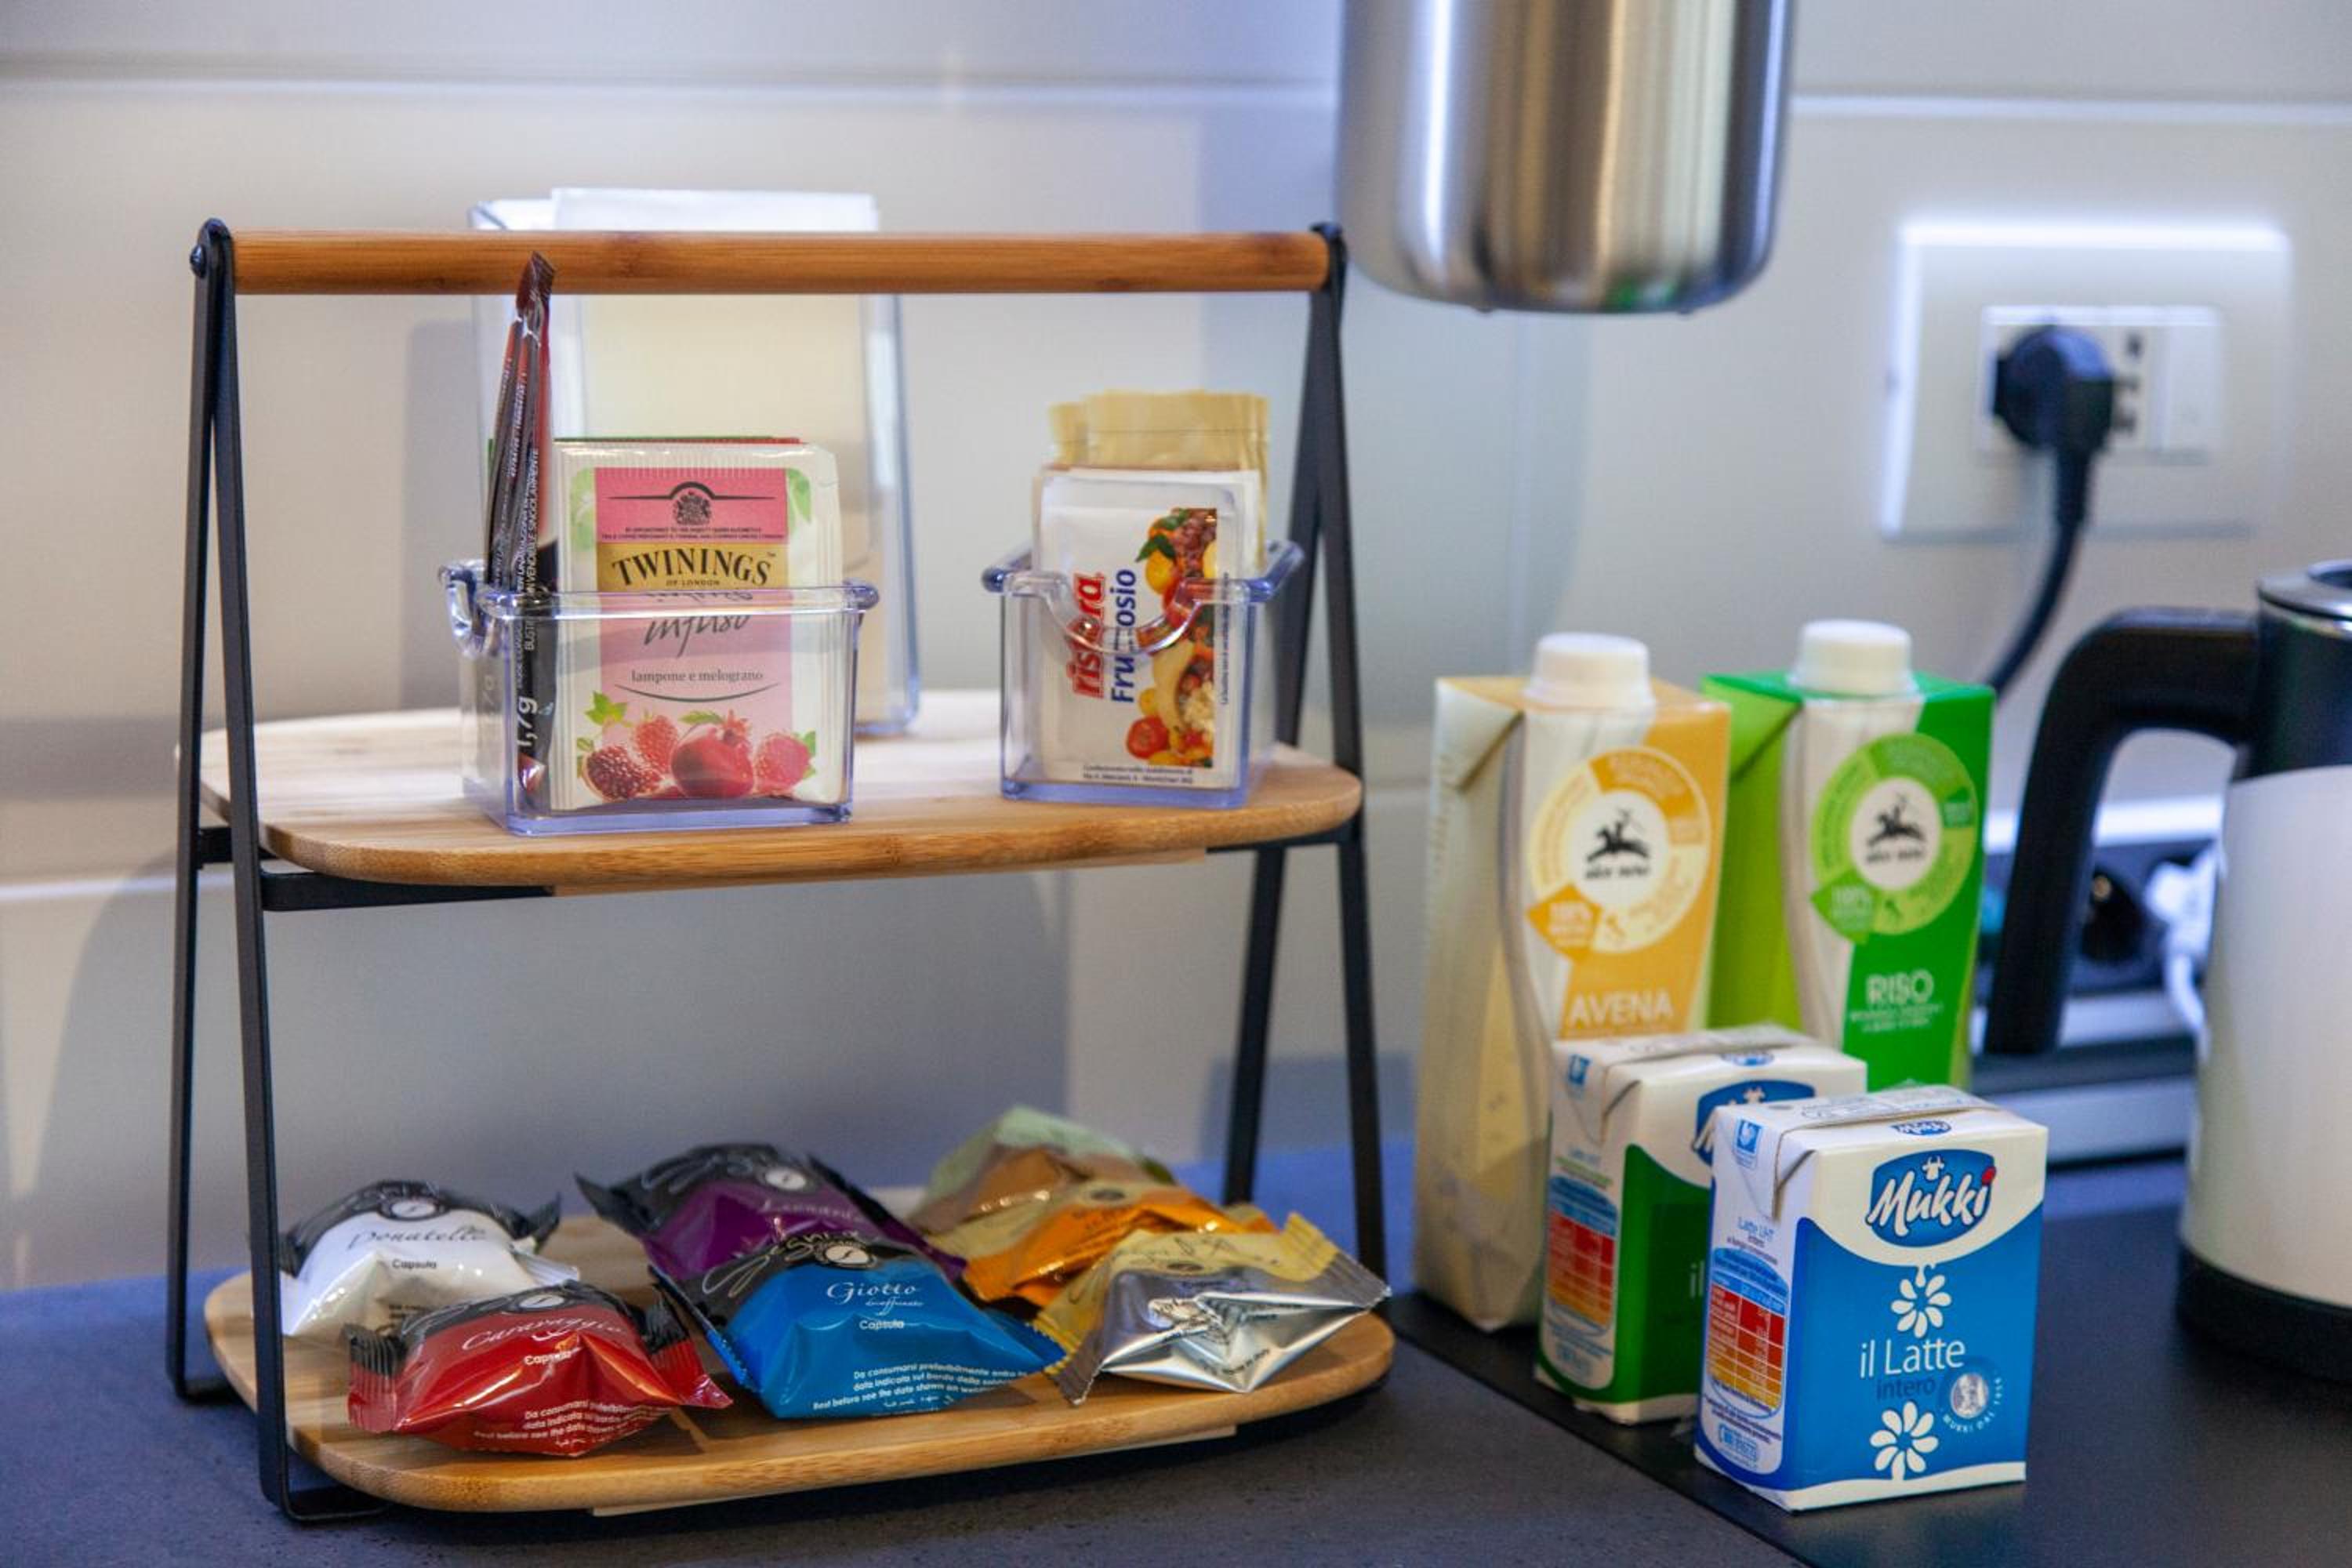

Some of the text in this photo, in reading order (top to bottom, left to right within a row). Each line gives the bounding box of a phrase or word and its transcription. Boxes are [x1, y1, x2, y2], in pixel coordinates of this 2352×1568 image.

[612, 547, 771, 586] TWININGS
[1110, 569, 1137, 703] Fruosio
[630, 669, 687, 684] lampone
[699, 669, 764, 685] melograno
[1865, 968, 1935, 1005] RISO
[1569, 988, 1675, 1028] AVENA
[1865, 1165, 1997, 1237] Mukki
[392, 1258, 437, 1270] Capsula
[1690, 1262, 1704, 1298] il
[826, 1282, 917, 1305] Giotto
[1860, 1338, 1965, 1378] il Latte
[812, 1401, 831, 1410] Best
[832, 1395, 860, 1408] before
[893, 1385, 914, 1396] date
[916, 1384, 944, 1392] shown
[853, 1381, 874, 1392] data
